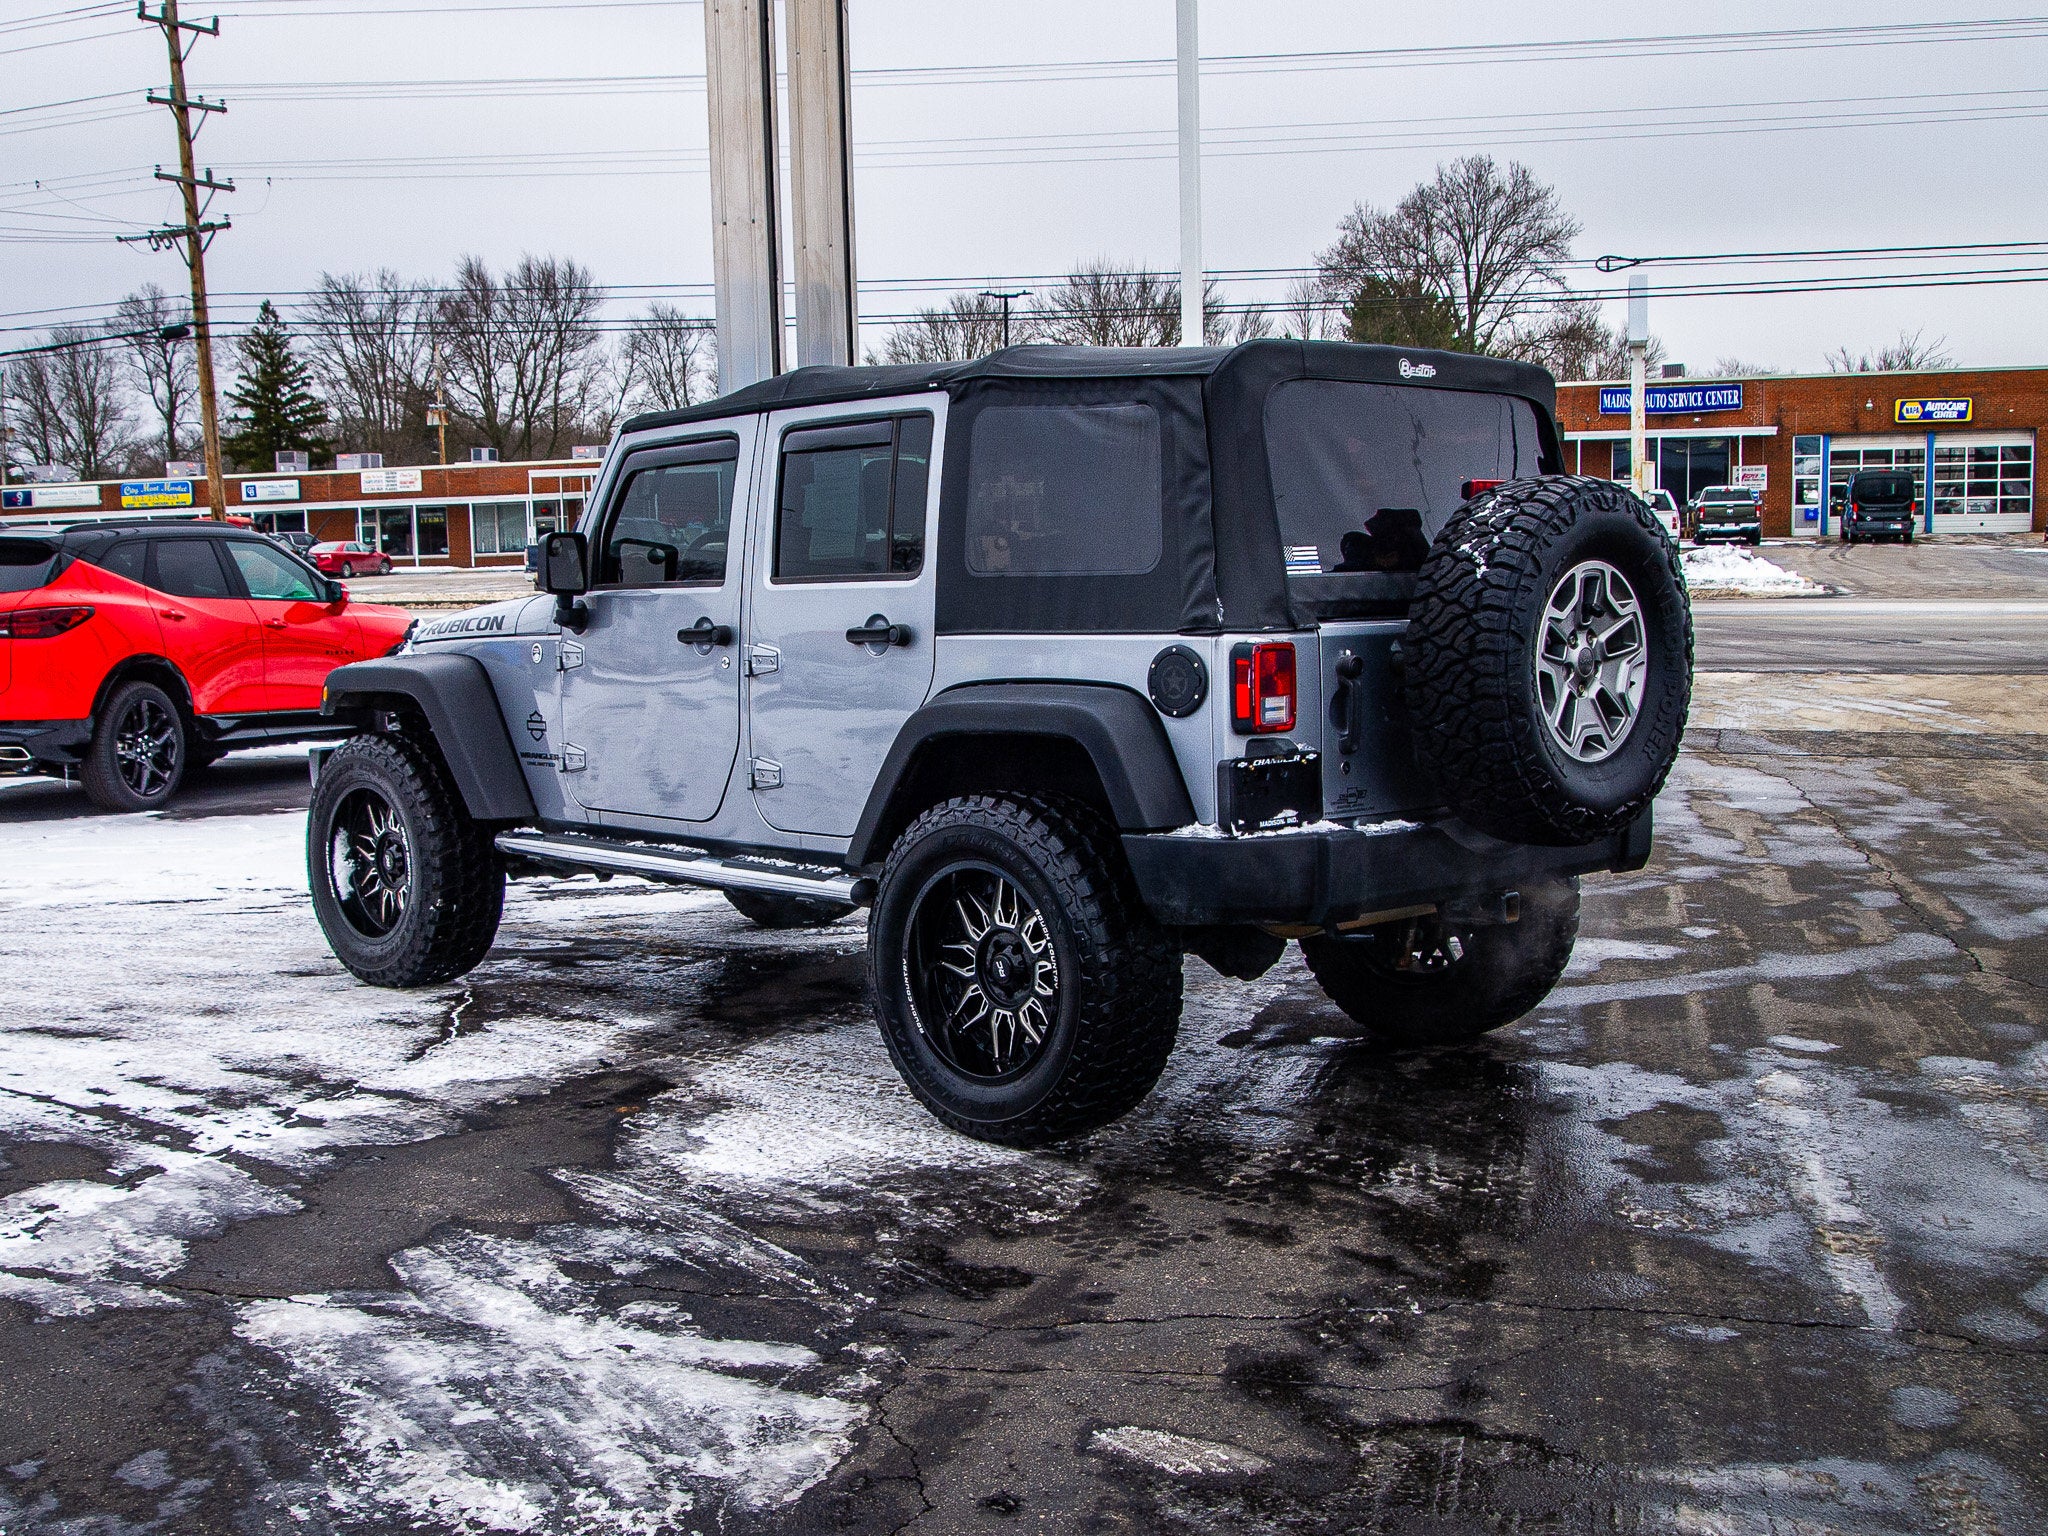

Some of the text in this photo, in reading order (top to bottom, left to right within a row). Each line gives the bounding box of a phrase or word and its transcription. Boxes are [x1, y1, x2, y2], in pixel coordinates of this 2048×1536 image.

[1603, 389, 1740, 408] MADIS AUTO SERVICE CENTER
[426, 615, 506, 636] RUBICON
[1642, 680, 1677, 763] POWER
[520, 752, 559, 760] WRANGLER
[1035, 908, 1059, 989] ROUGH COUNTRY
[902, 958, 925, 1034] ROUGH COUNTRY
